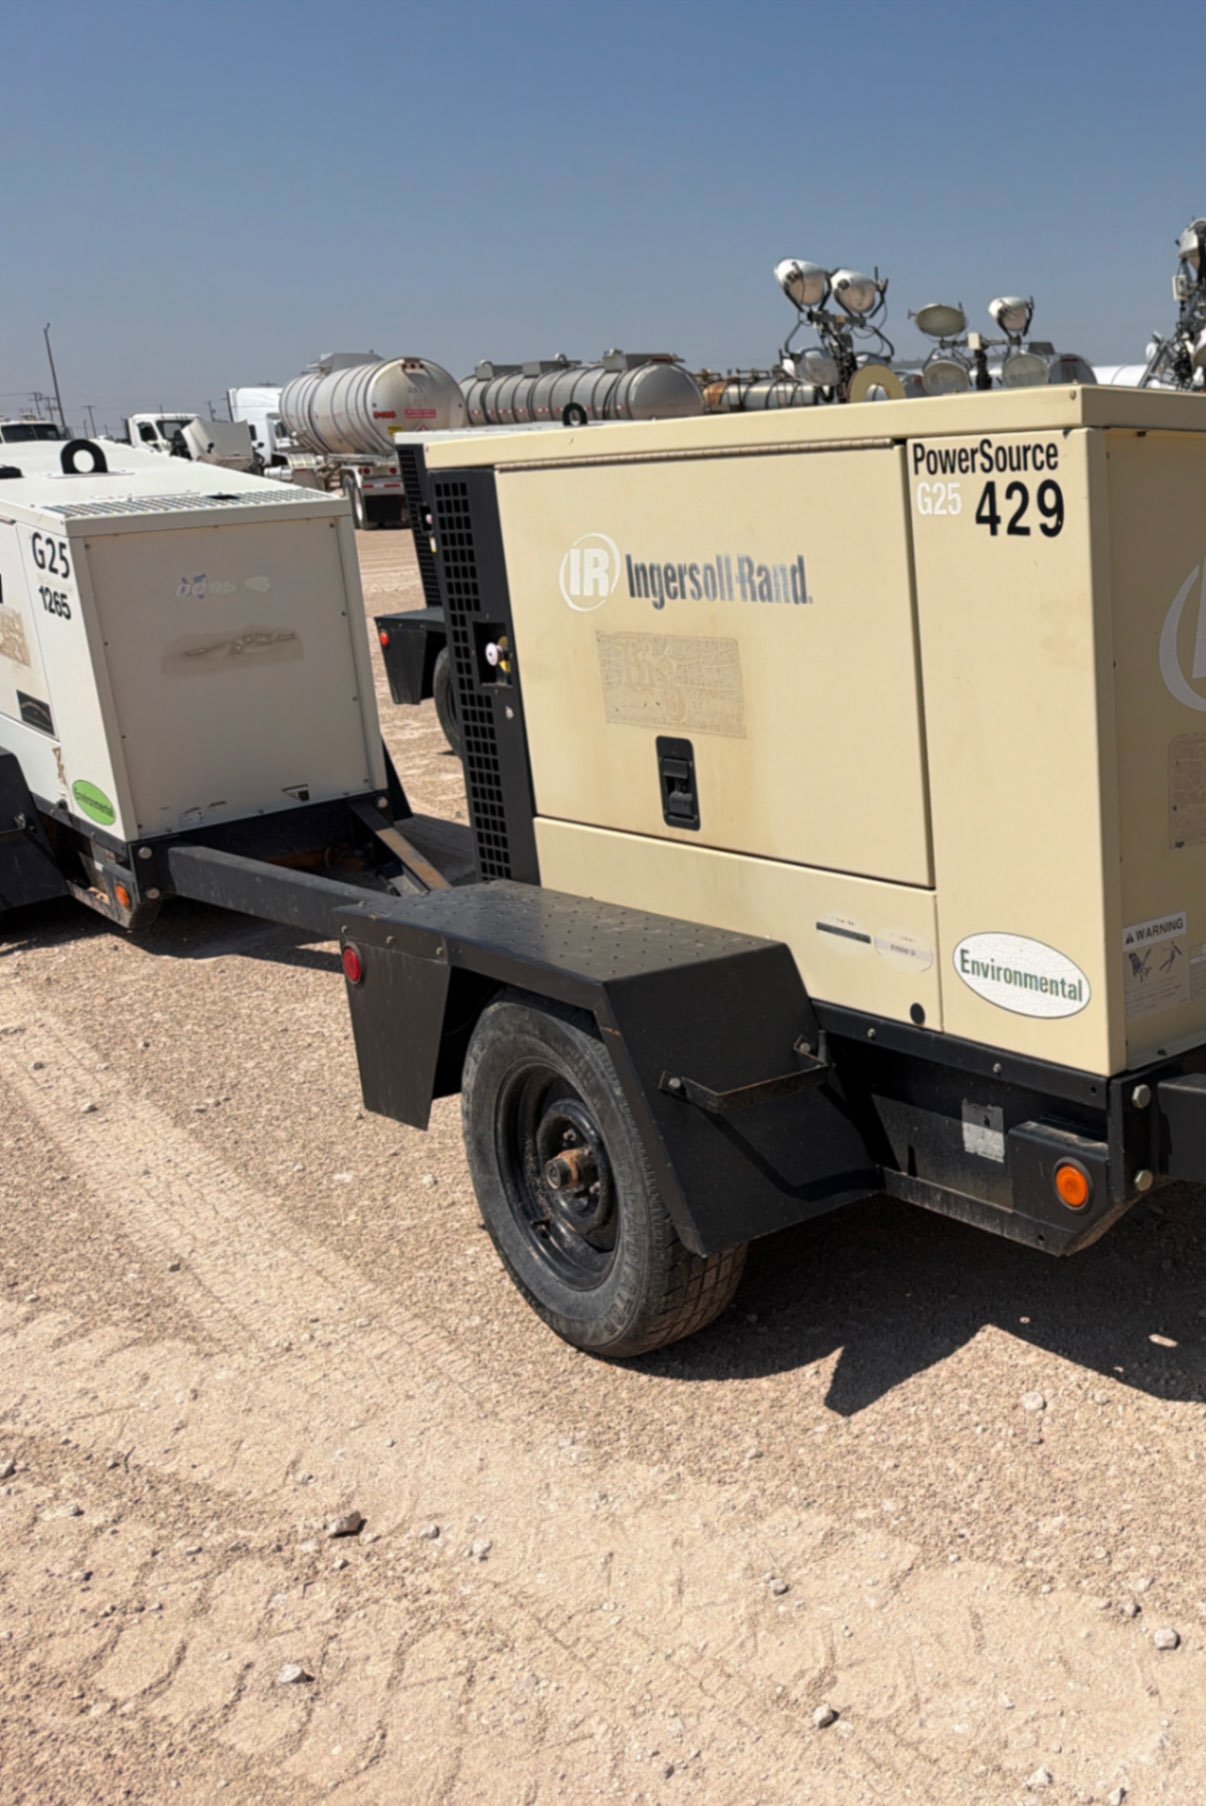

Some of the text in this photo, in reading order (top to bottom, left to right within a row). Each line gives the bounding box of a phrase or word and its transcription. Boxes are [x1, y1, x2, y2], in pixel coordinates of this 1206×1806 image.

[912, 438, 1059, 476] PowerSource
[916, 478, 1065, 538] G25 429
[31, 531, 71, 579] G25
[569, 548, 610, 597] IR
[38, 584, 72, 621] 1265
[1135, 917, 1184, 941] WARNING
[959, 948, 1083, 1002] Environmental
